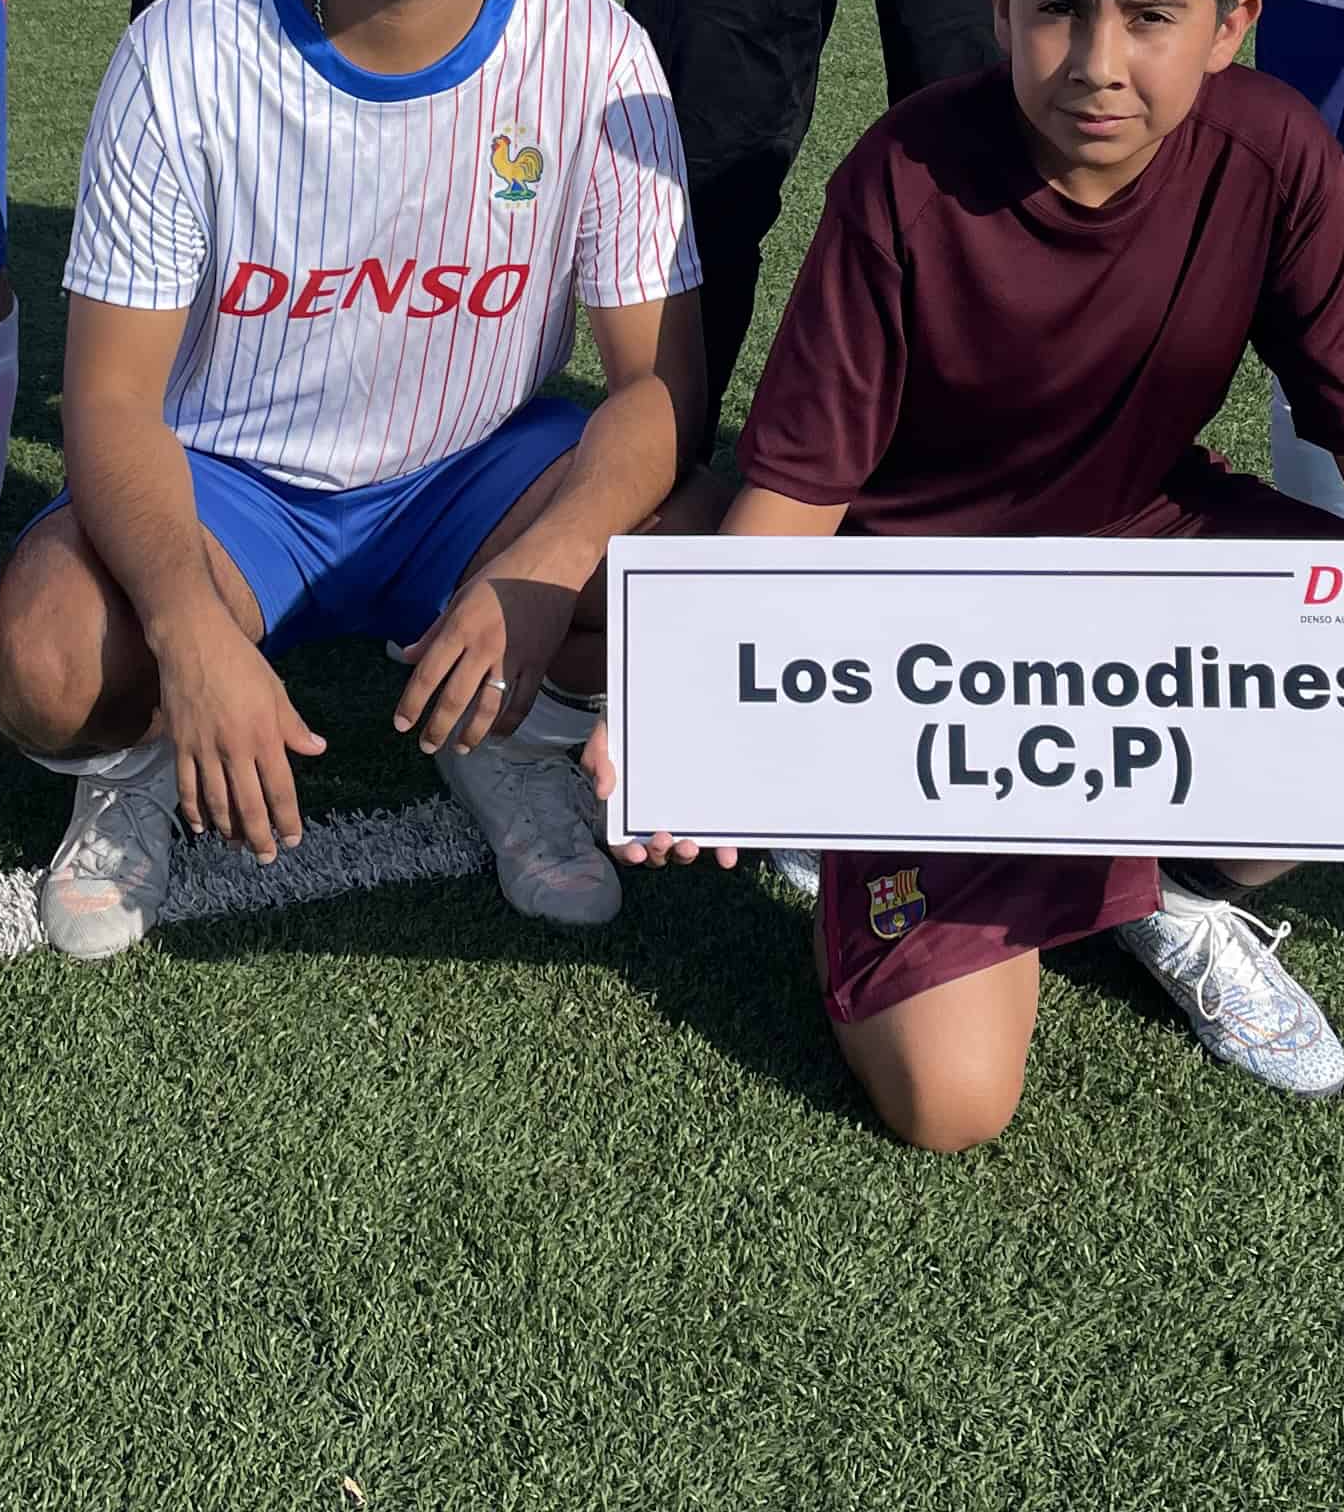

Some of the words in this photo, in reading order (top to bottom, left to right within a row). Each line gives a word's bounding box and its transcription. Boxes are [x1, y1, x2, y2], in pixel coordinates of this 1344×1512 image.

[220, 258, 531, 319] DENSO
[1300, 615, 1332, 624] DENSO
[738, 643, 872, 704] Los
[915, 723, 1193, 805] (L,C,P)
